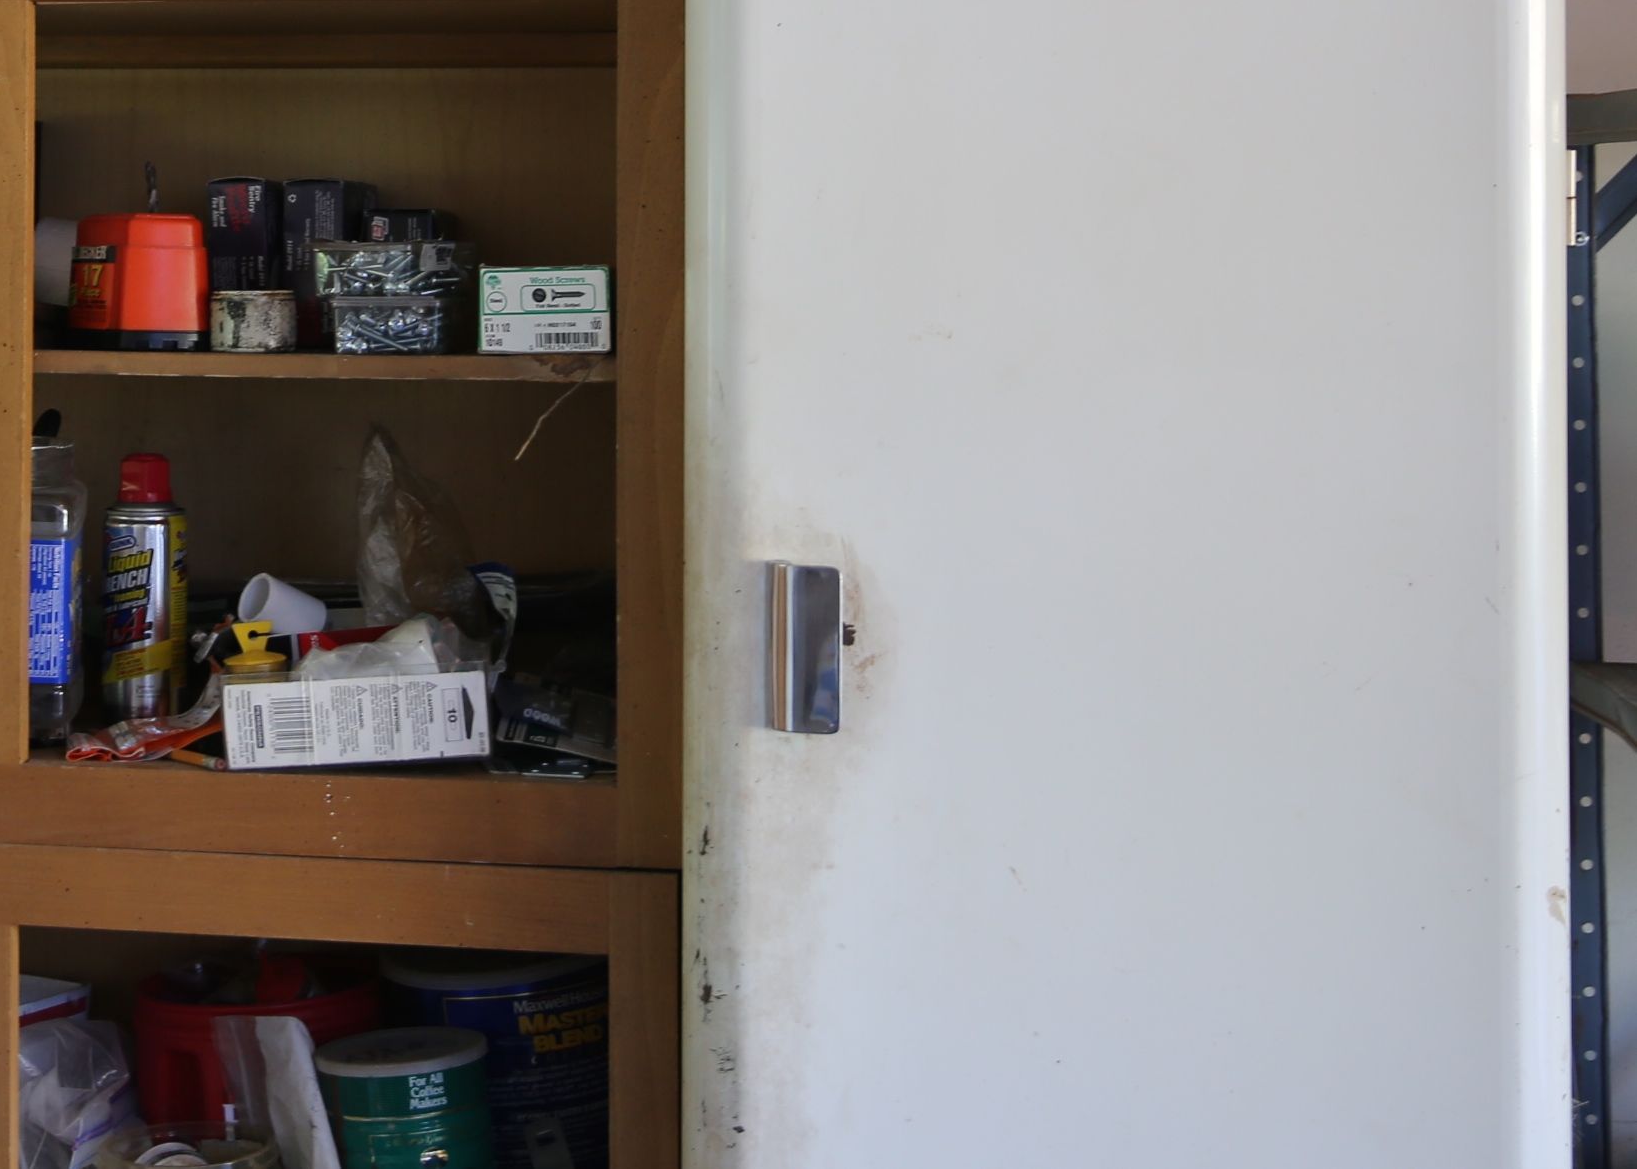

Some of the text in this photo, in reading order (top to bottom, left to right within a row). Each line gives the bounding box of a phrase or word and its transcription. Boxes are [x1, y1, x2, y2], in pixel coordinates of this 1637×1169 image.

[82, 263, 104, 287] 17
[554, 276, 586, 284] Screws
[446, 707, 458, 724] 10
[409, 1075, 427, 1088] For
[410, 1085, 446, 1098] Coffee
[409, 1096, 448, 1111] Makers
